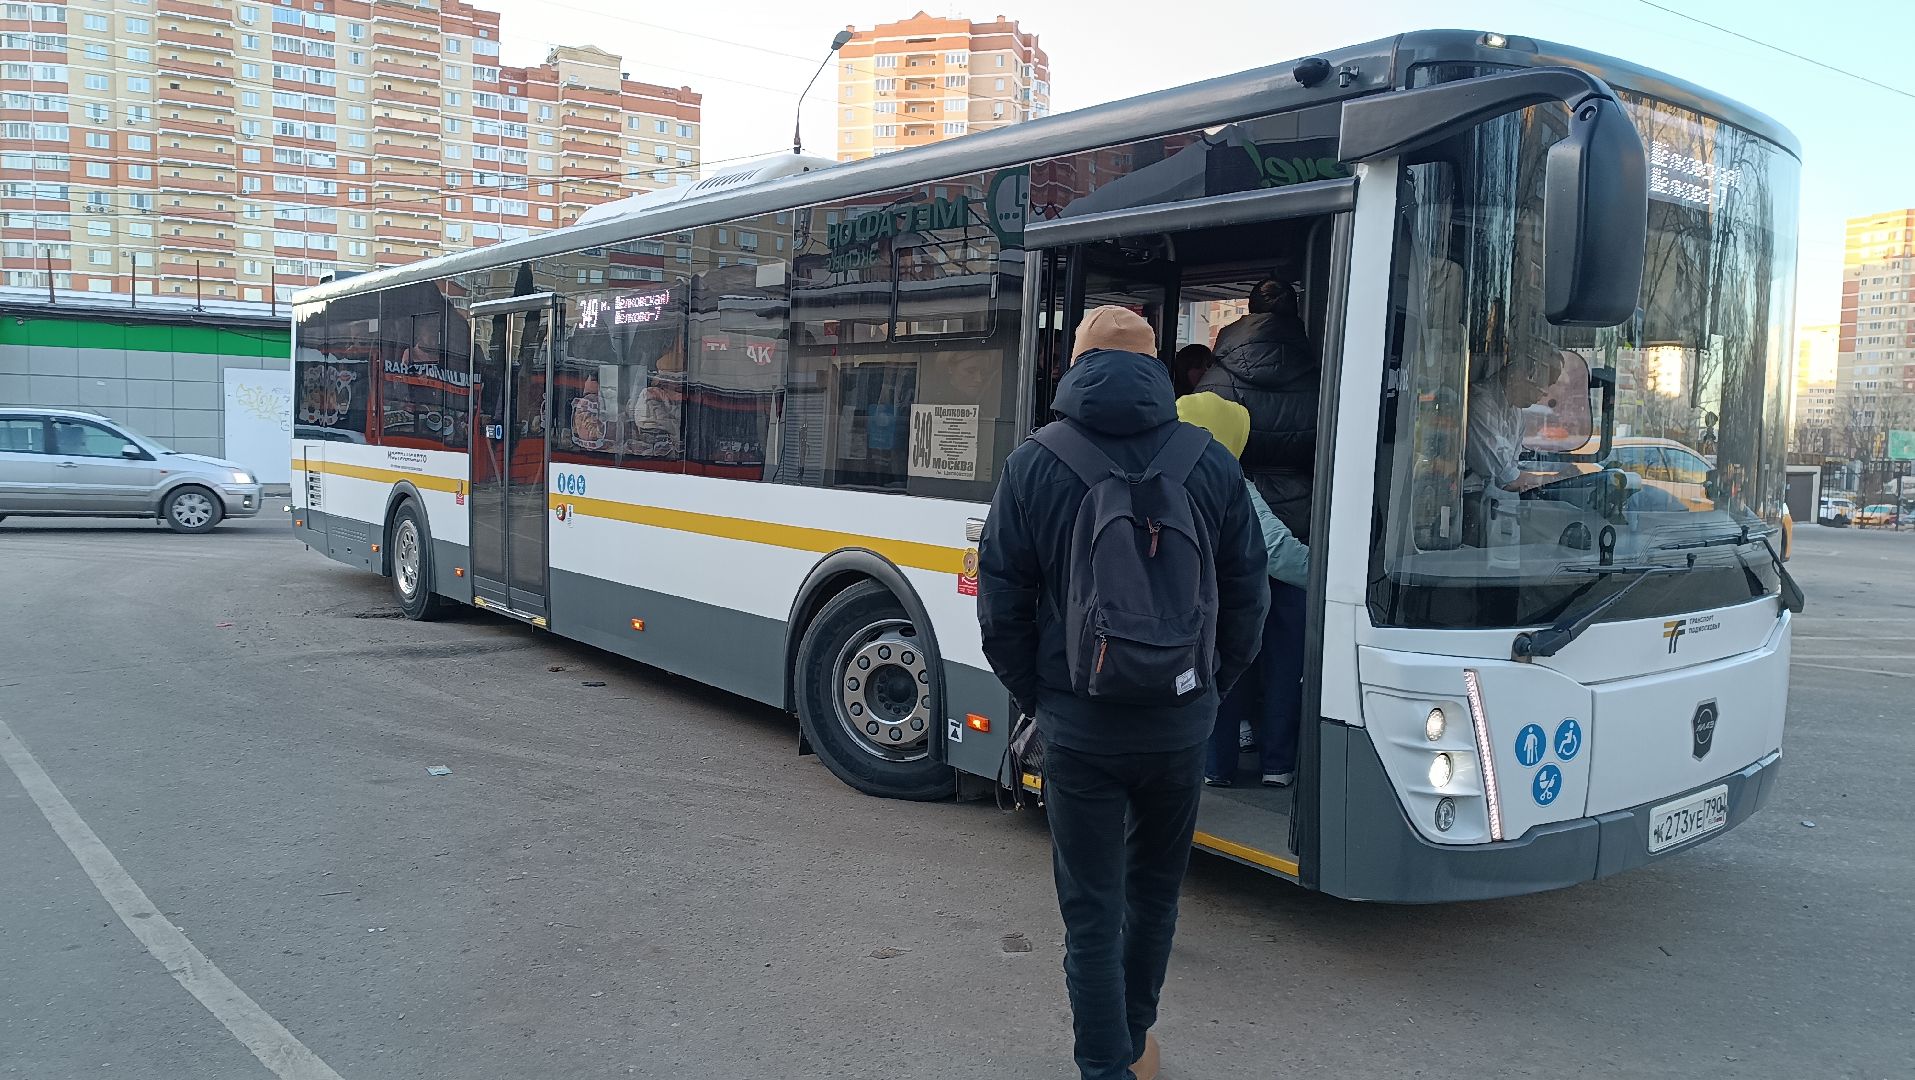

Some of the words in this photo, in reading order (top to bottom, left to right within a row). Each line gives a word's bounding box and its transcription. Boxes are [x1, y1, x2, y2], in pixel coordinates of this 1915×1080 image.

[579, 298, 599, 328] 349
[913, 411, 933, 468] 349
[932, 457, 974, 471] Москва
[1653, 808, 1704, 844] К273УЕ
[1705, 796, 1723, 818] 790
